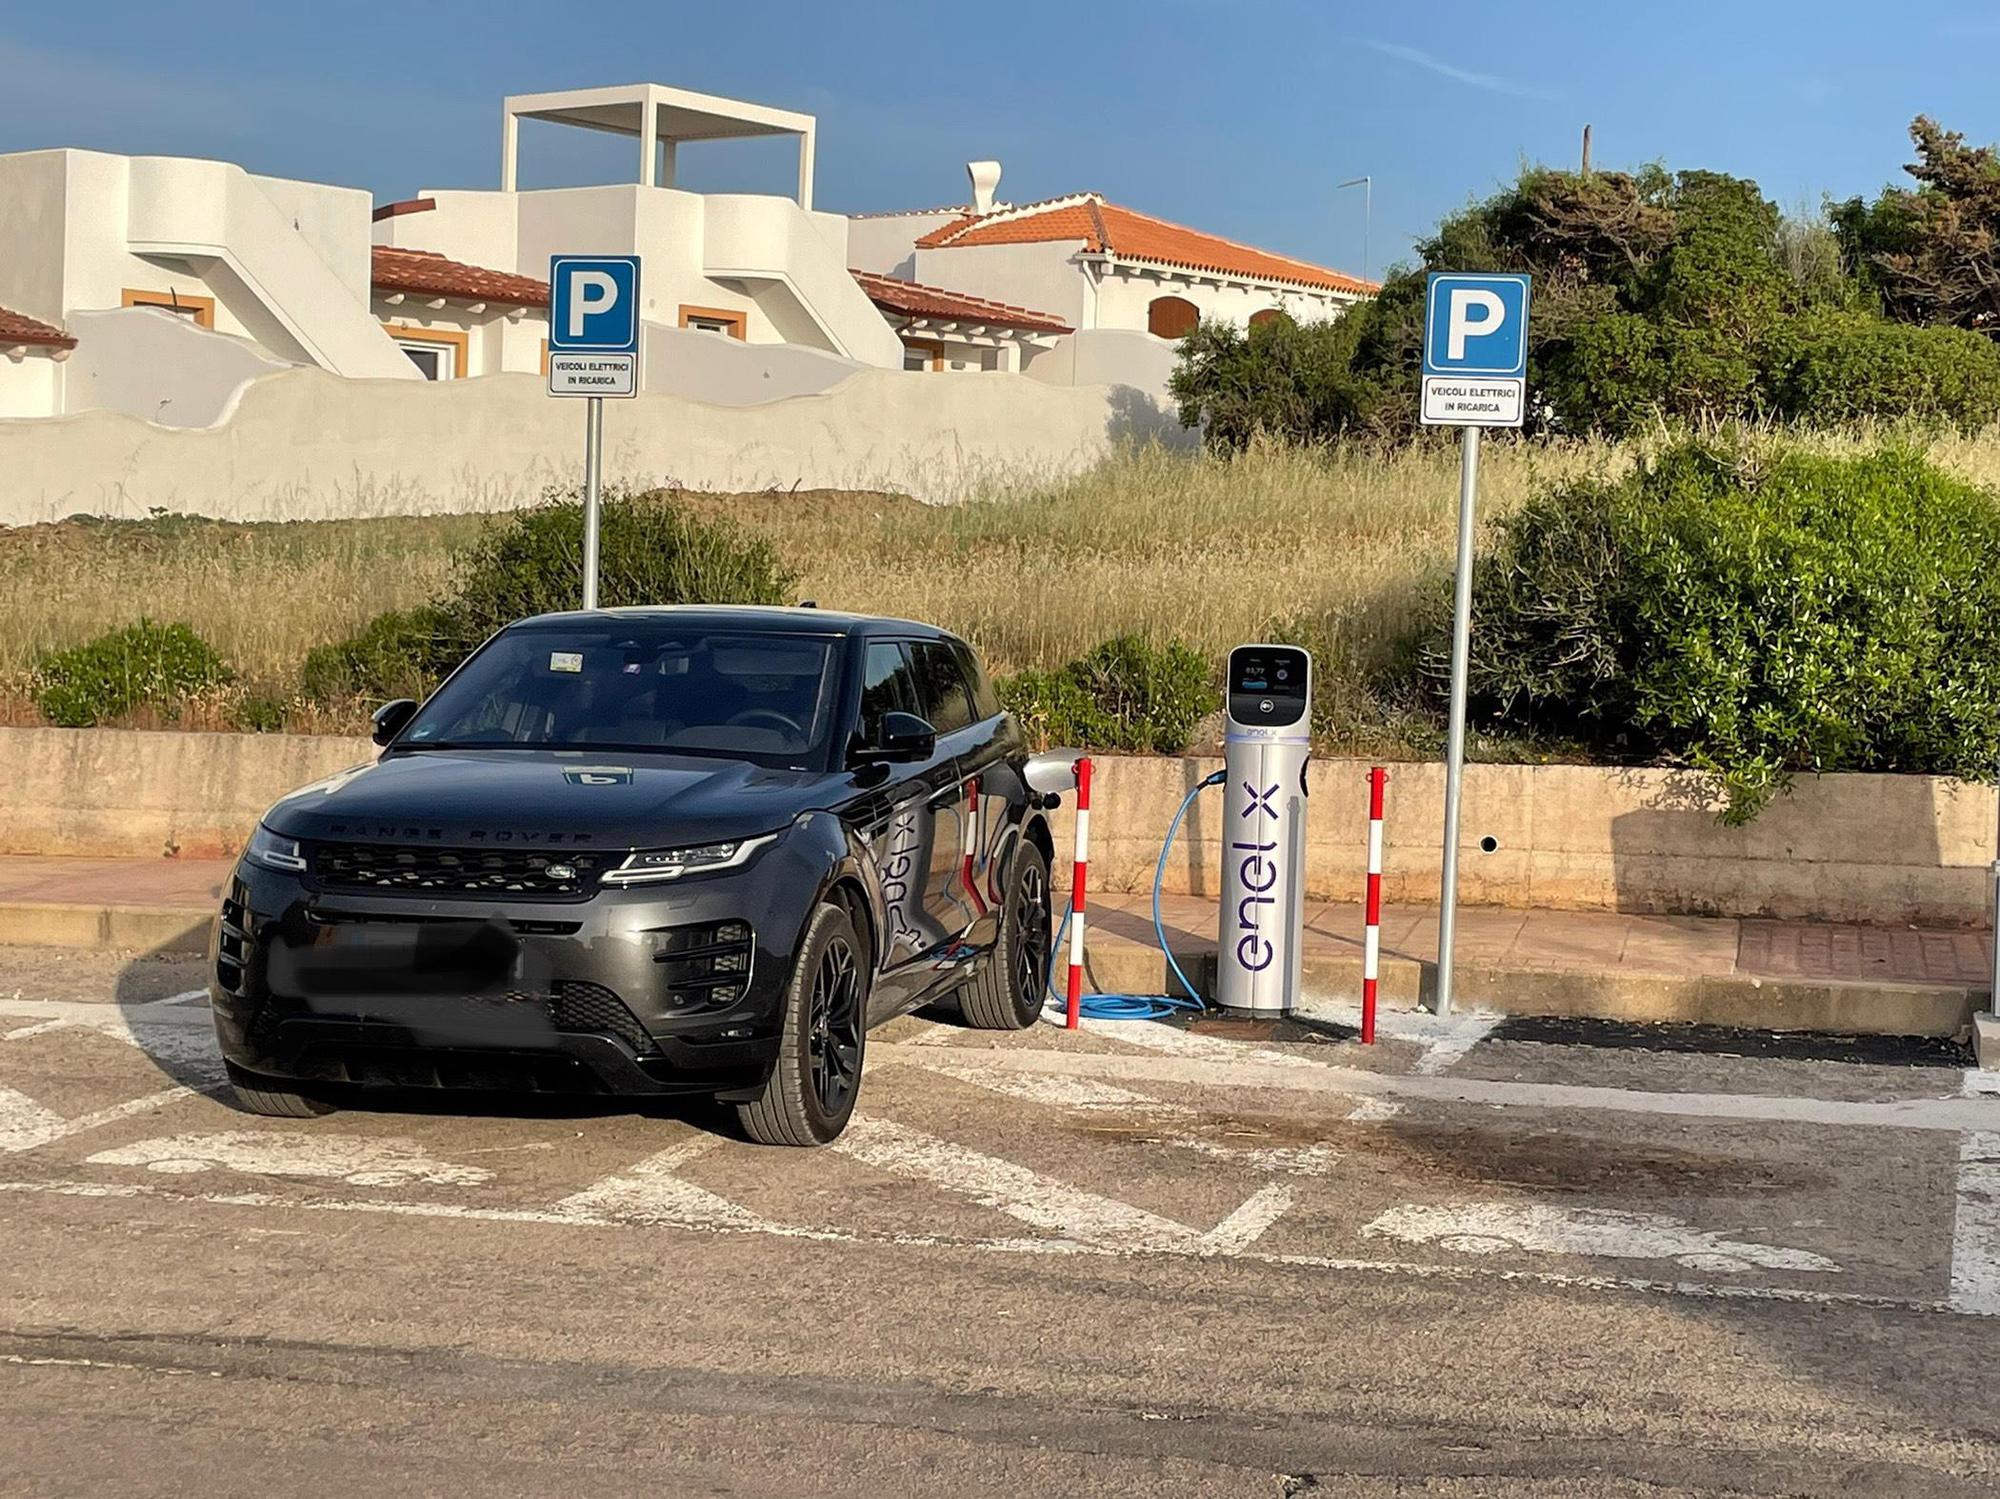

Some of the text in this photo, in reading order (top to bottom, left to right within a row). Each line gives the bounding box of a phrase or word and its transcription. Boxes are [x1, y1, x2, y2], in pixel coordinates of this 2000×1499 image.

[569, 271, 618, 336] P
[1447, 289, 1506, 360] P
[555, 362, 629, 372] VEICOLI ELETTRICI
[567, 376, 616, 385] IN RICARICA
[1431, 387, 1516, 398] VEICOLI ELETTRICI
[1444, 402, 1501, 412] IN RICARICA
[329, 825, 593, 844] RANGE ROVER
[1232, 841, 1278, 972] enel
